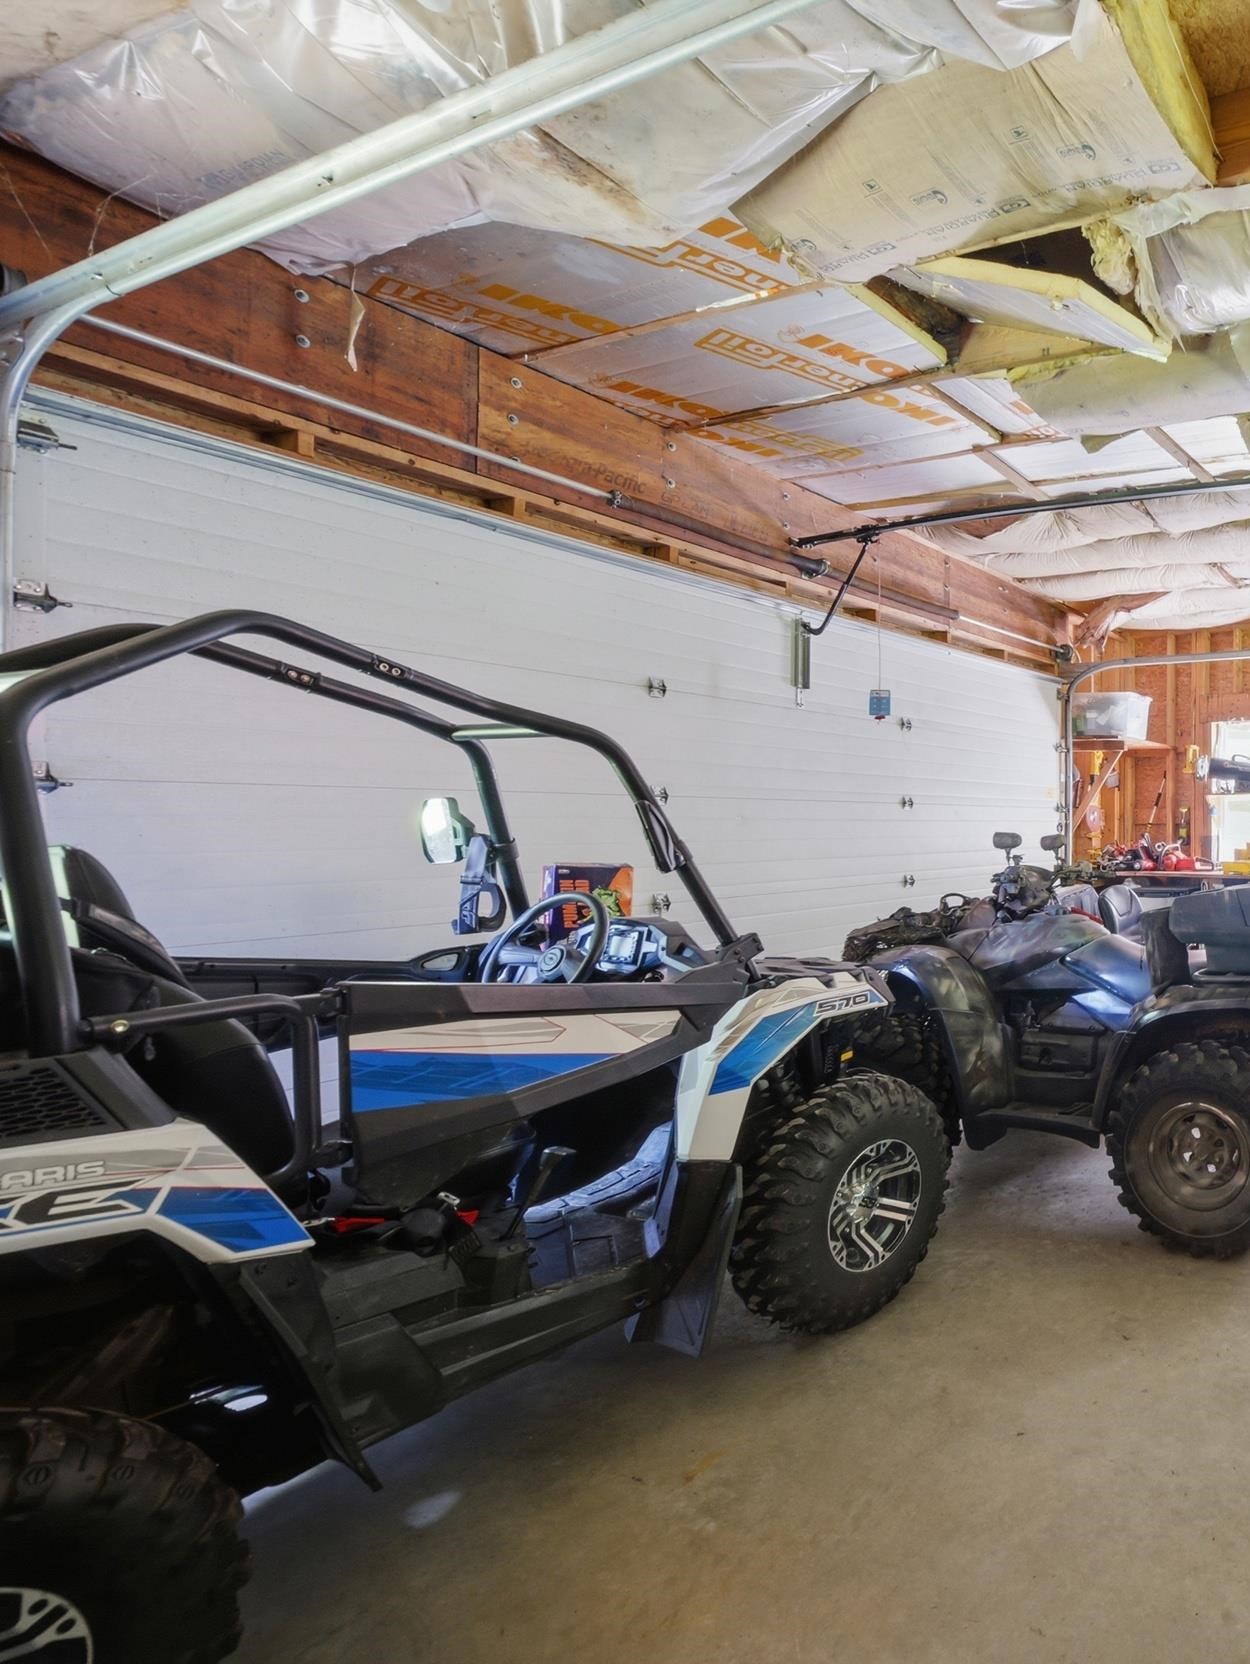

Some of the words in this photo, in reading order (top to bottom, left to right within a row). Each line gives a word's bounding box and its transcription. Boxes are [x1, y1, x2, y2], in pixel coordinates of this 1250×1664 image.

[797, 334, 911, 379] IKO
[607, 381, 724, 419] IKO
[817, 994, 870, 1015] 570
